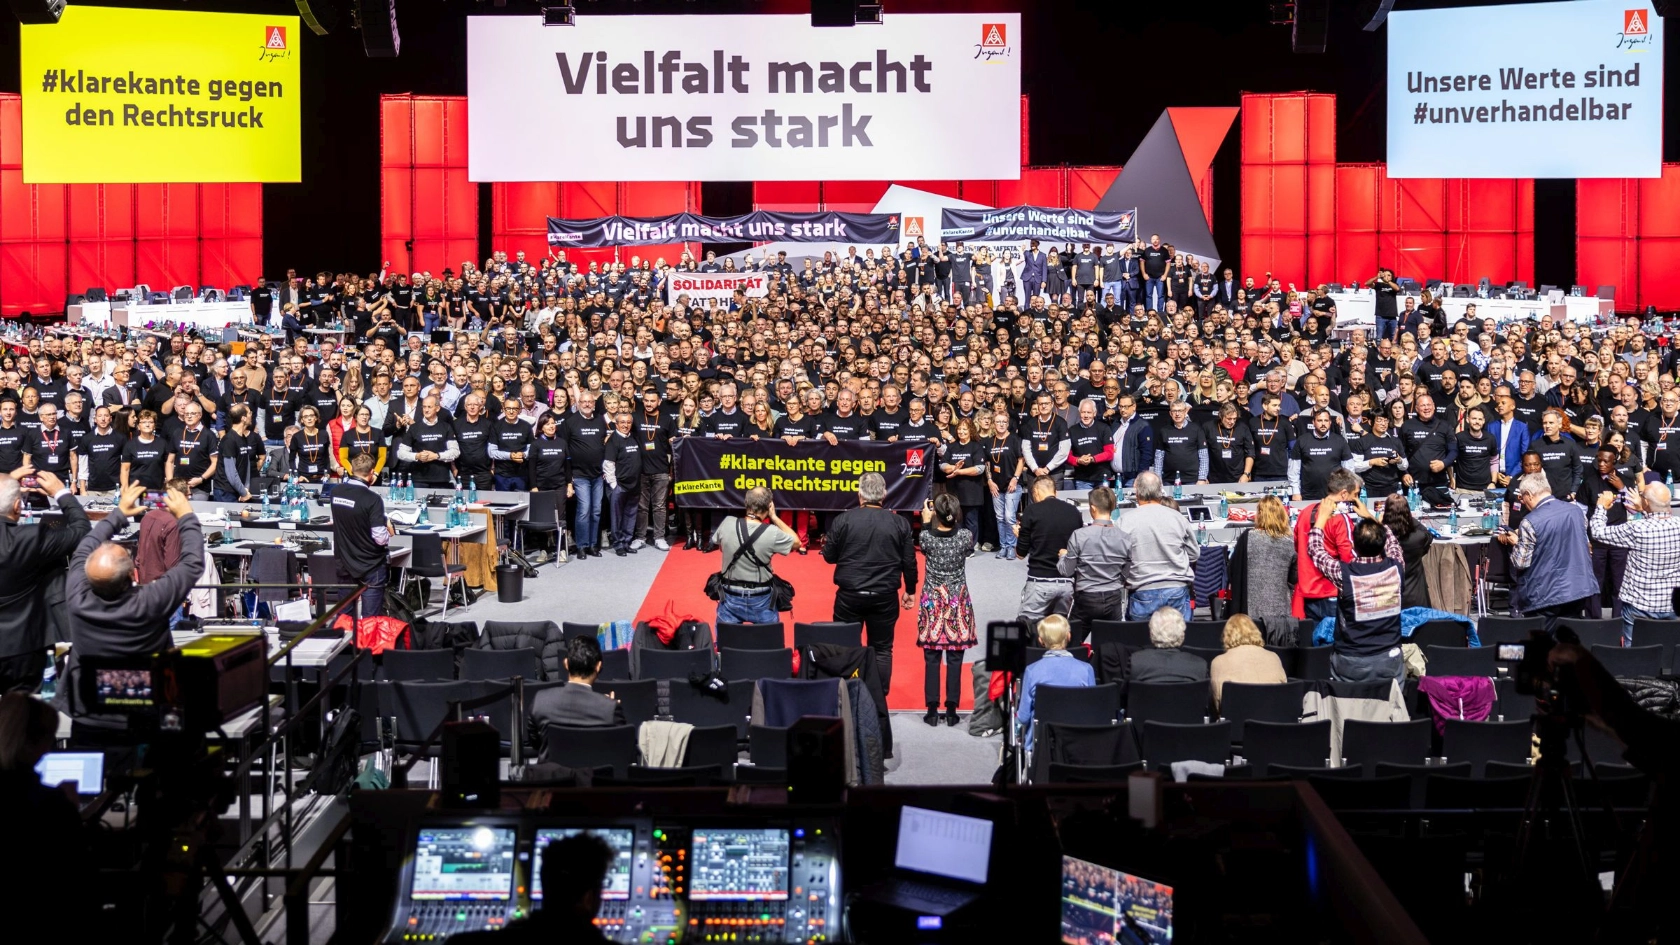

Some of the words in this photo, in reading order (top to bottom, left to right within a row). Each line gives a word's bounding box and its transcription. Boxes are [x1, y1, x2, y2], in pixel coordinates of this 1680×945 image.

[556, 50, 750, 95] Vielfalt
[769, 50, 933, 94] macht
[1407, 71, 1491, 94] Unsere
[1499, 67, 1576, 91] Werte
[1584, 62, 1640, 88] sind
[42, 69, 200, 97] #klarekante
[208, 79, 283, 102] gegen
[65, 102, 114, 127] den
[123, 104, 264, 129] Rechtsruck
[1413, 97, 1632, 125] #unverhandelbar
[616, 115, 713, 149] uns
[731, 103, 874, 148] stark
[602, 222, 676, 240] Vielfalt
[682, 222, 744, 237] macht
[748, 221, 786, 236] uns
[791, 218, 847, 237] stark
[982, 212, 1025, 224] Unsere
[1027, 210, 1065, 223] Werte
[1067, 213, 1094, 226] sind
[985, 224, 1091, 239] #unverhandelbar
[719, 454, 826, 471] #klarekante
[830, 459, 886, 475] gegen
[677, 482, 722, 491] #klareKante
[735, 474, 767, 490] den
[771, 475, 860, 492] Rechtsruc
